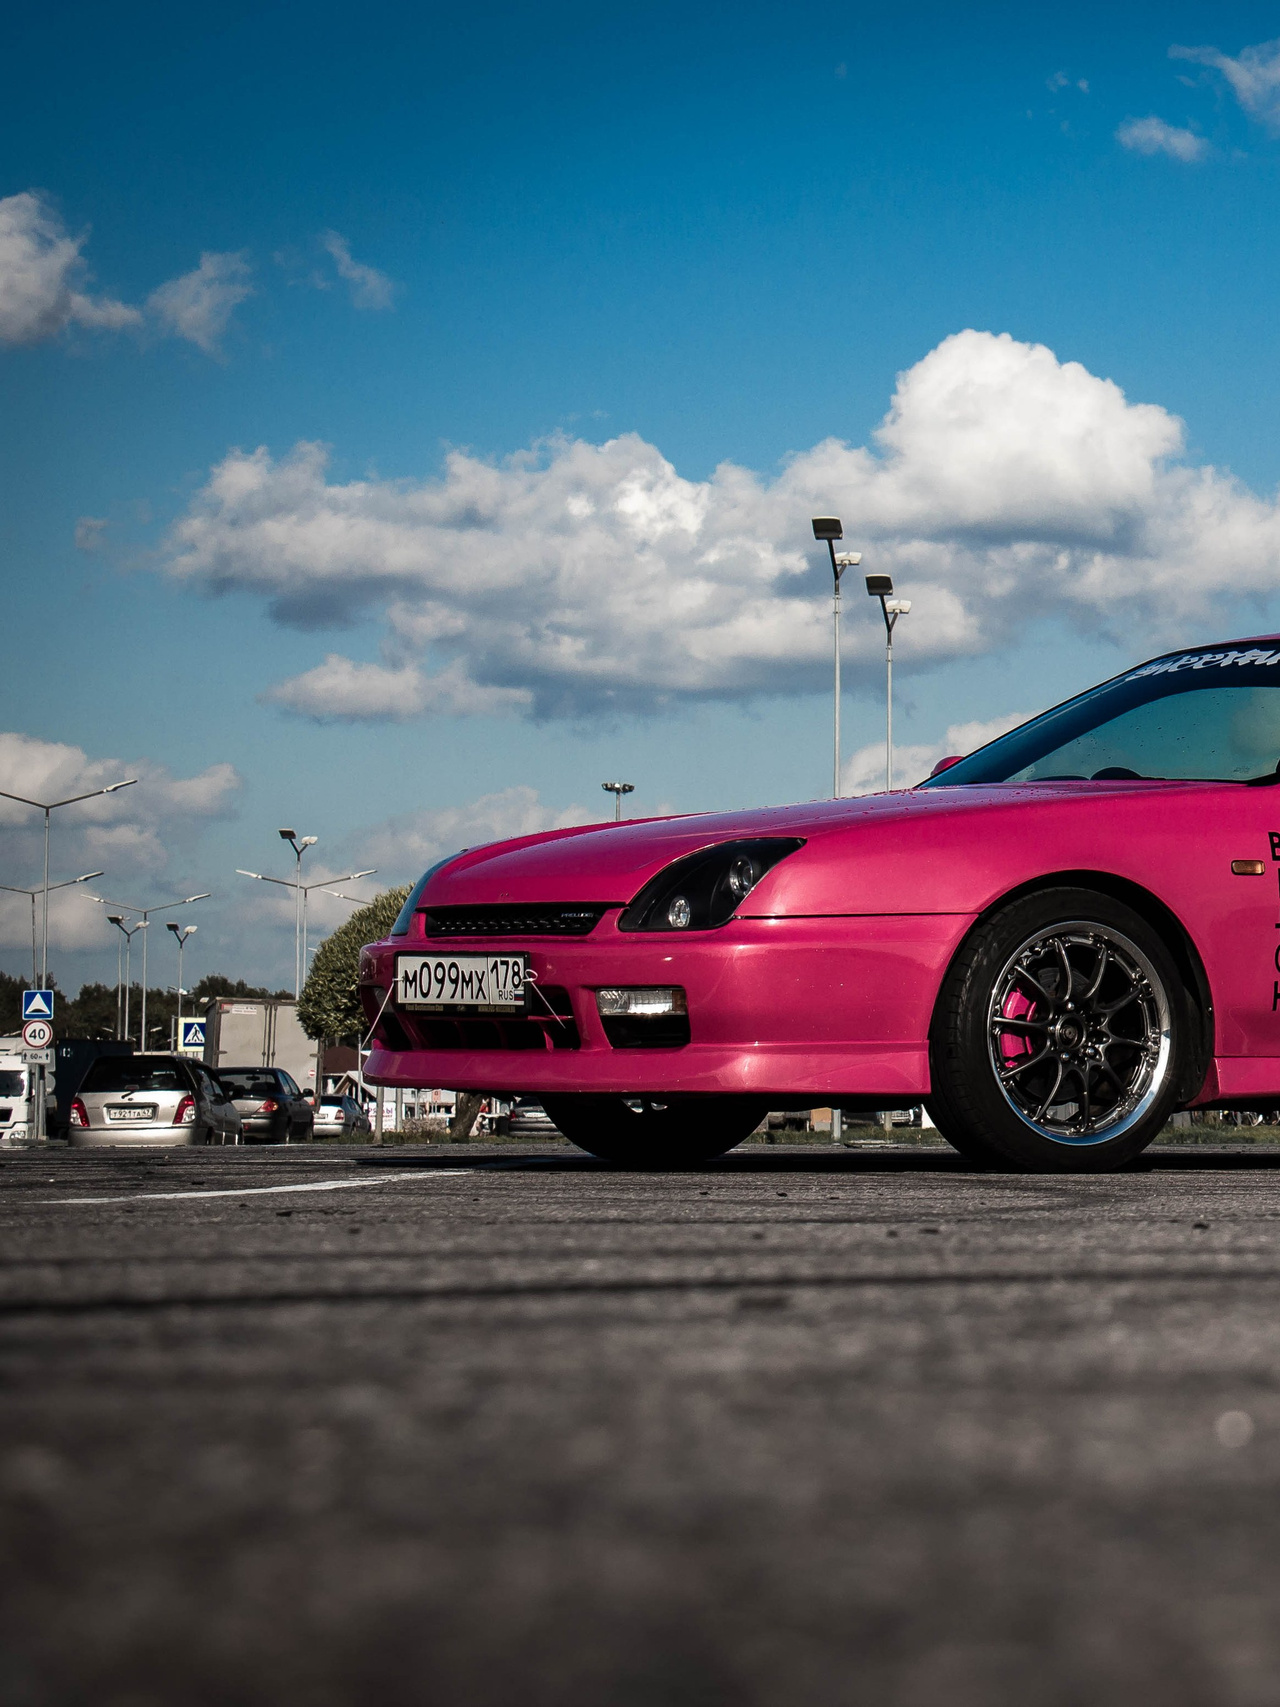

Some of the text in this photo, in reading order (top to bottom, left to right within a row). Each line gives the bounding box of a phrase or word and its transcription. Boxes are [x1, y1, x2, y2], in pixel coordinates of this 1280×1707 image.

[490, 959, 521, 989] 178
[498, 990, 514, 1001] RUS
[29, 1028, 46, 1040] 40
